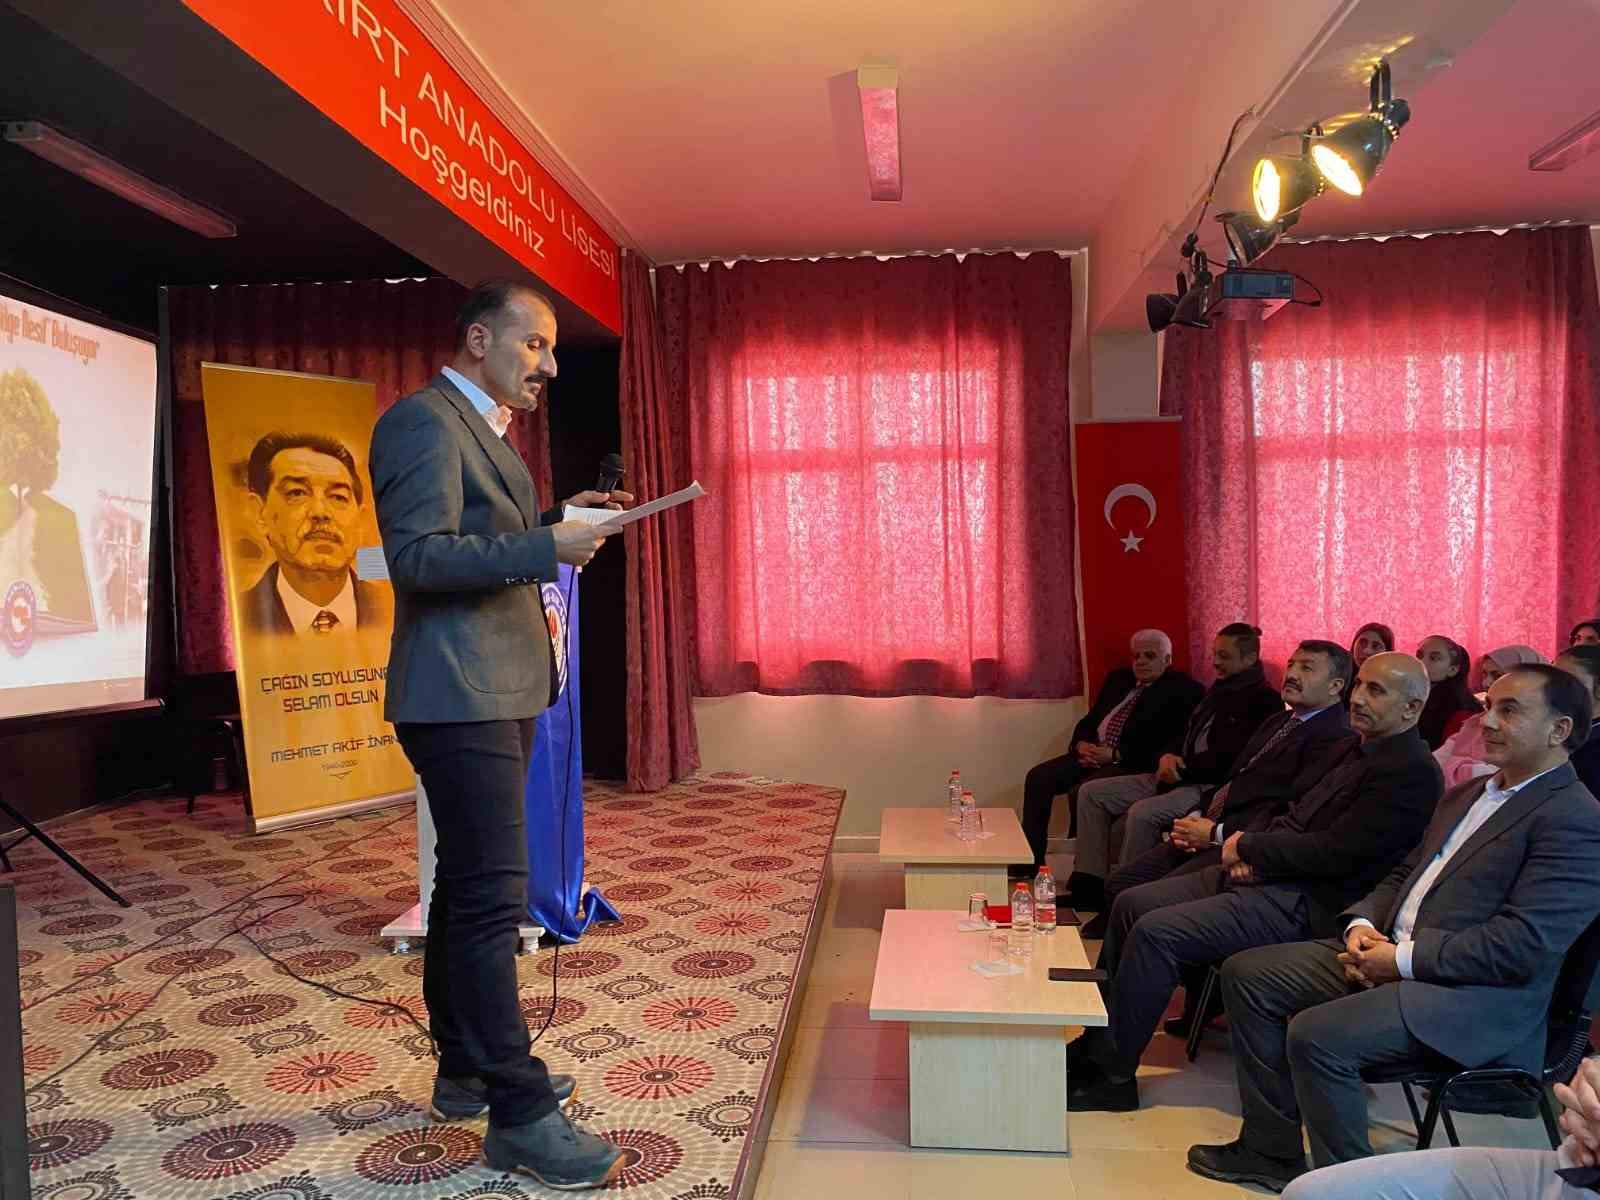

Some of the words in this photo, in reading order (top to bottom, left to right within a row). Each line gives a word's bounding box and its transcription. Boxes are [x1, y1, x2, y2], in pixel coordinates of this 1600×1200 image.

[379, 85, 545, 258] Hoşgeldiniz
[418, 71, 555, 223] ANADOLU
[283, 694, 331, 713] SELAM
[335, 688, 379, 706] OLSUN
[271, 744, 329, 763] MEHMET
